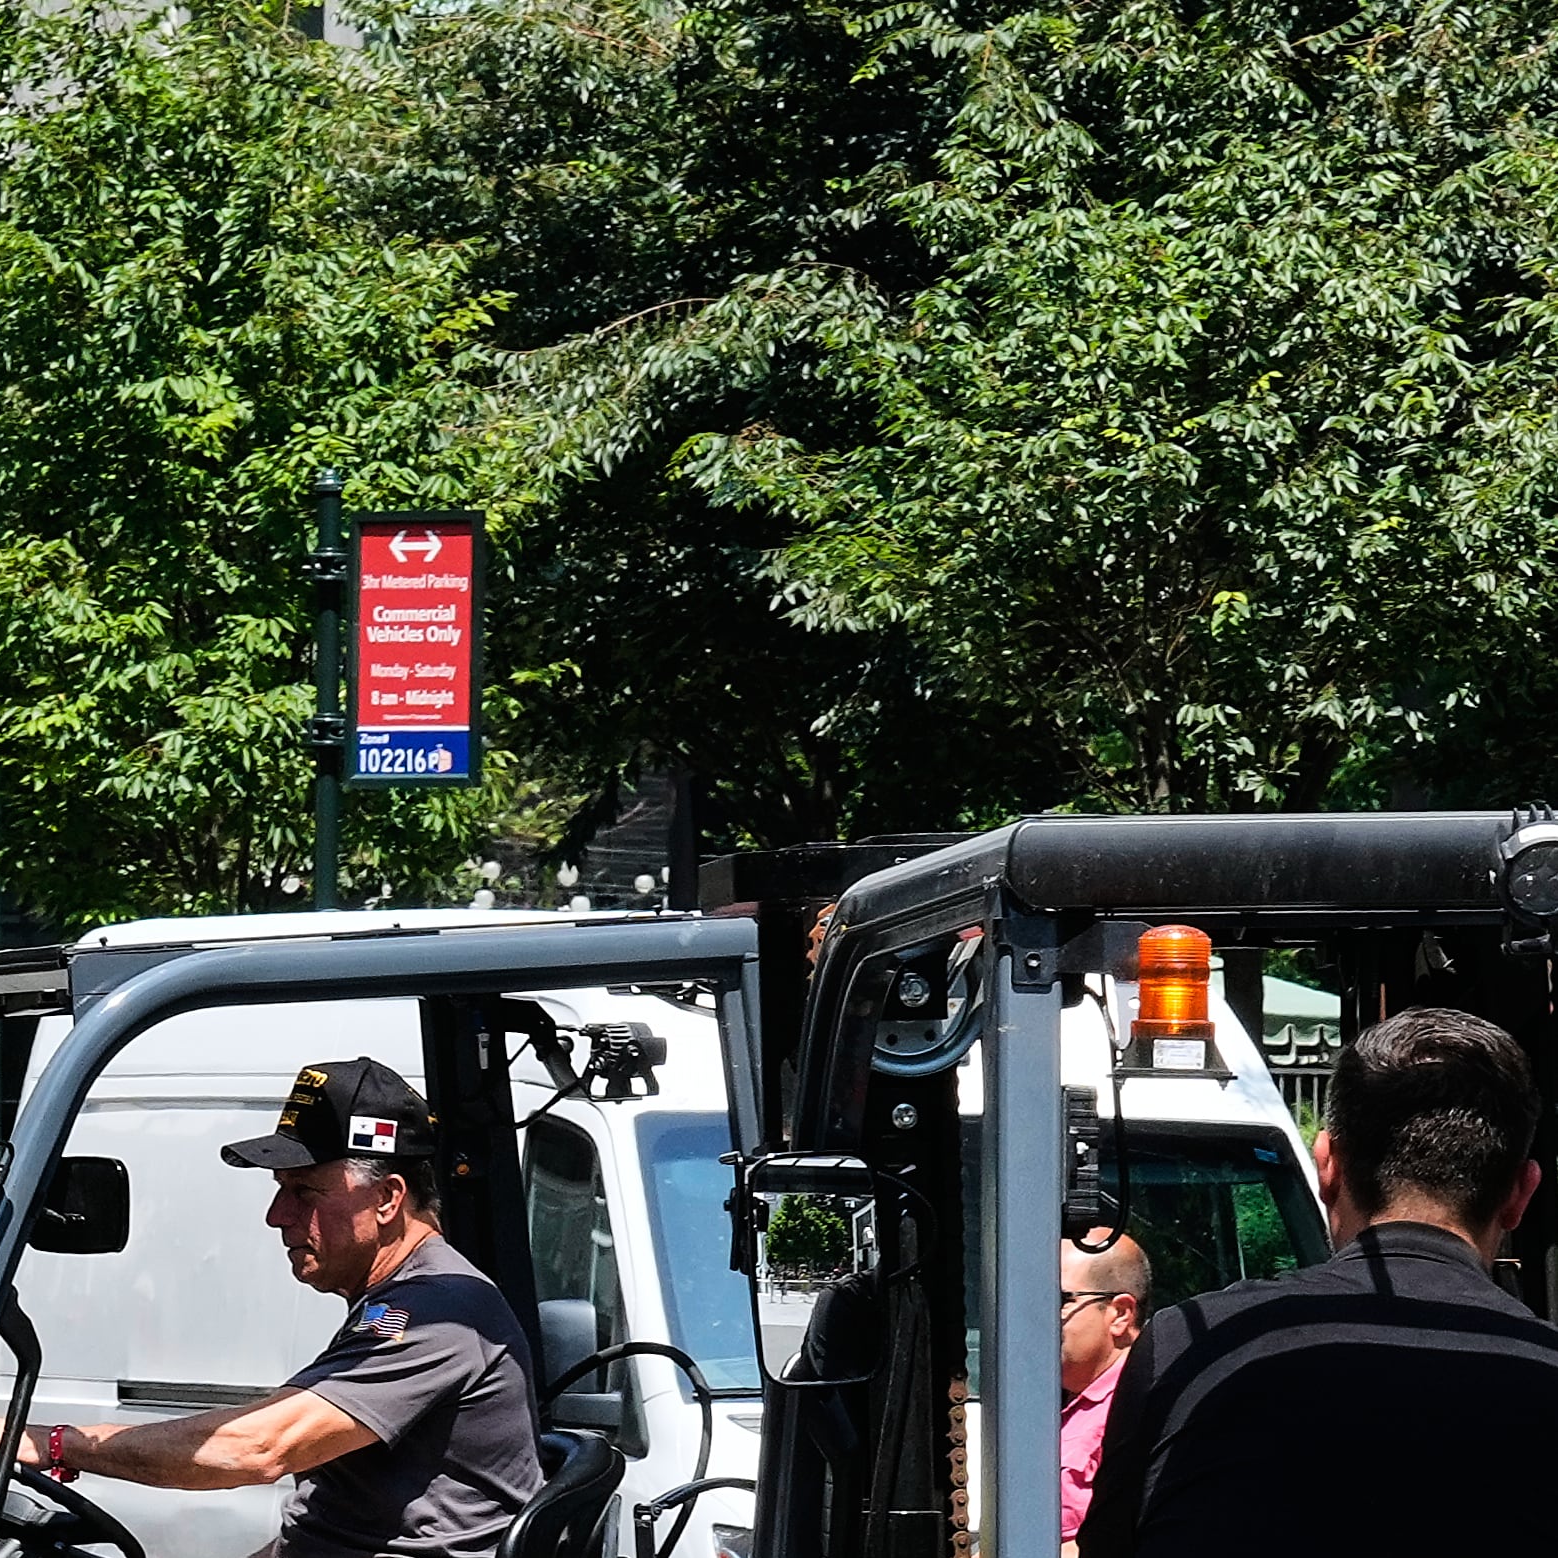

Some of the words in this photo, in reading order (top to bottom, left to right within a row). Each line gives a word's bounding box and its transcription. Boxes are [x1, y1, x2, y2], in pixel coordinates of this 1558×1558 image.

[381, 574, 426, 589] Metered
[427, 574, 469, 592] Parking
[373, 604, 456, 622] Commercial
[366, 624, 424, 643] Vehicles
[426, 624, 462, 647] Only
[370, 663, 409, 681] Monday
[414, 662, 457, 681] Saturday
[405, 689, 455, 709] Midnight
[359, 748, 427, 773] 102216
